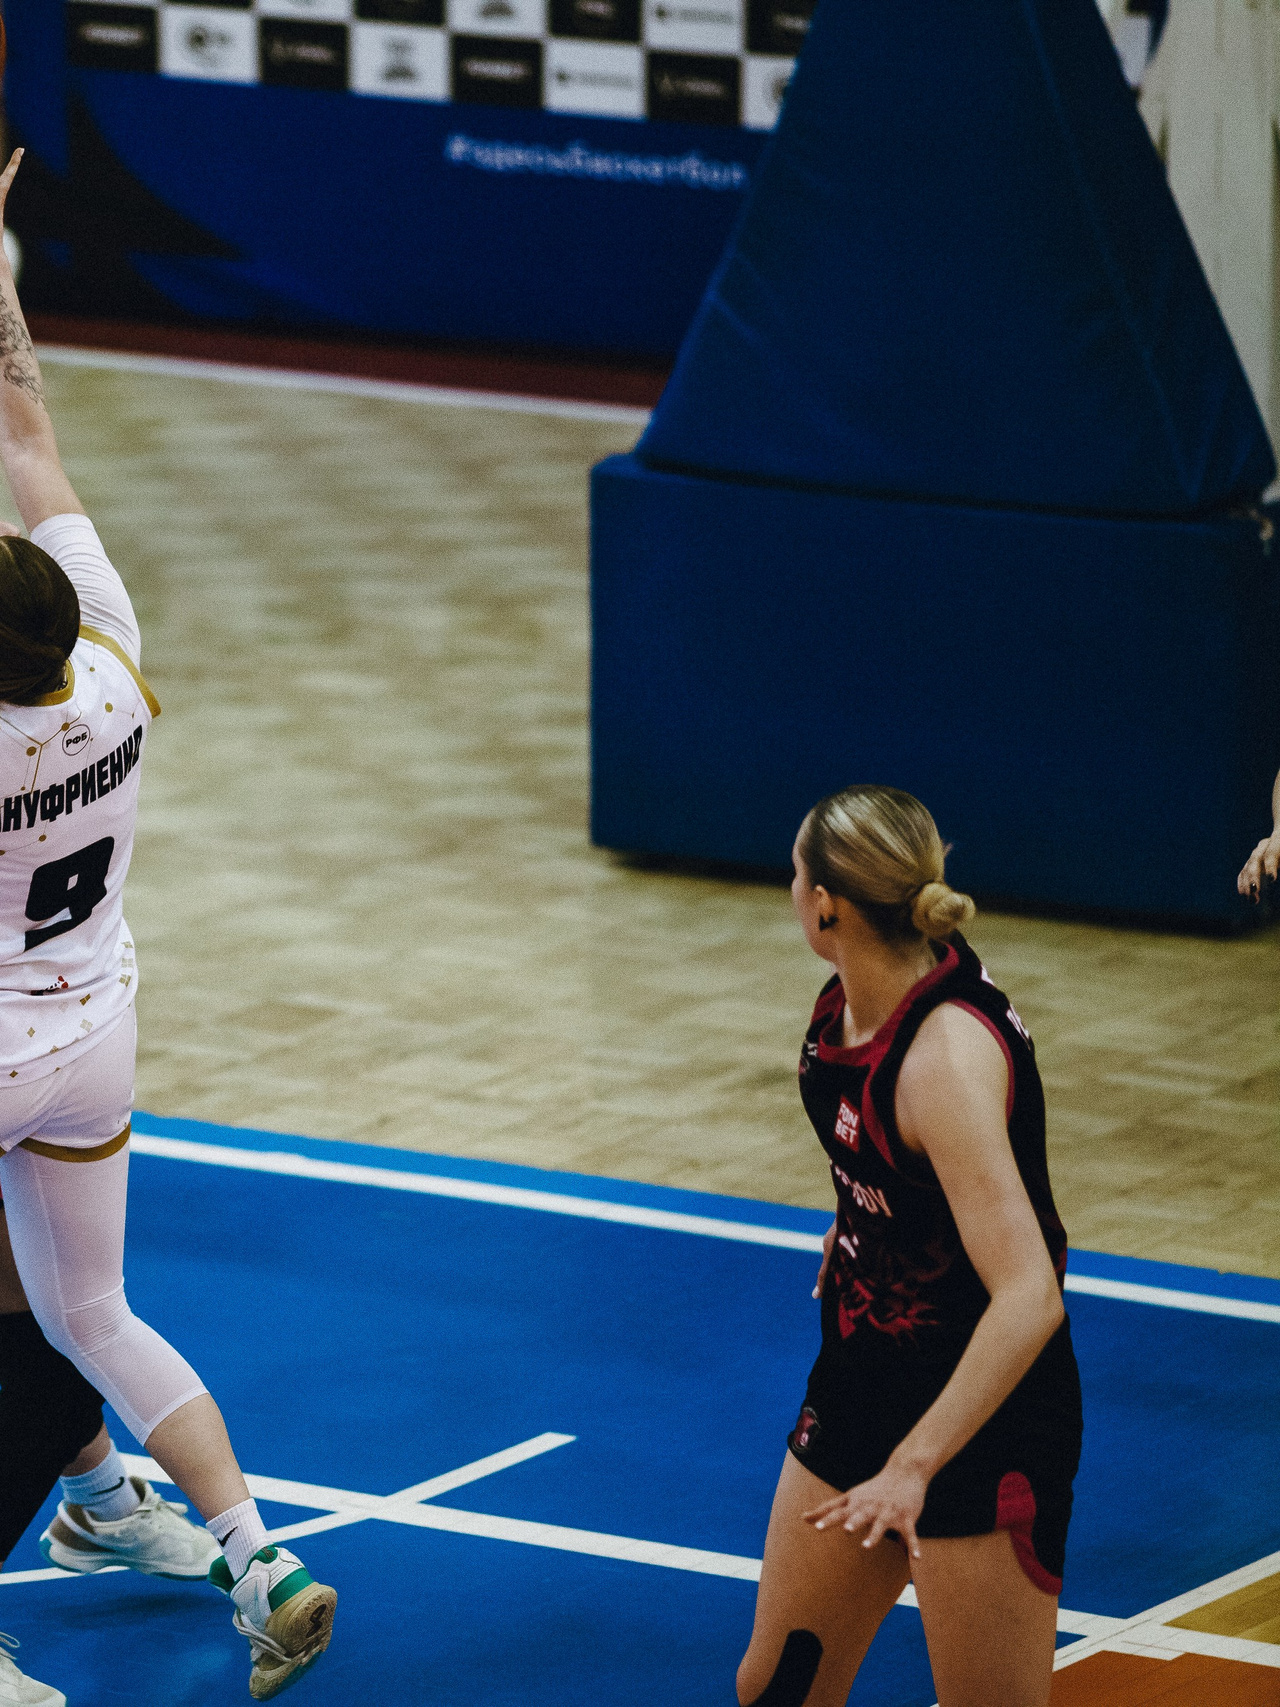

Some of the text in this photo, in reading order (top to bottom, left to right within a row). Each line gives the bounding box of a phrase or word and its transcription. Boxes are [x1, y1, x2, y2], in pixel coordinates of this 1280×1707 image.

[65, 732, 88, 748] РФБ
[24, 836, 115, 952] 9
[838, 1102, 859, 1128] FON
[835, 1119, 857, 1143] BET
